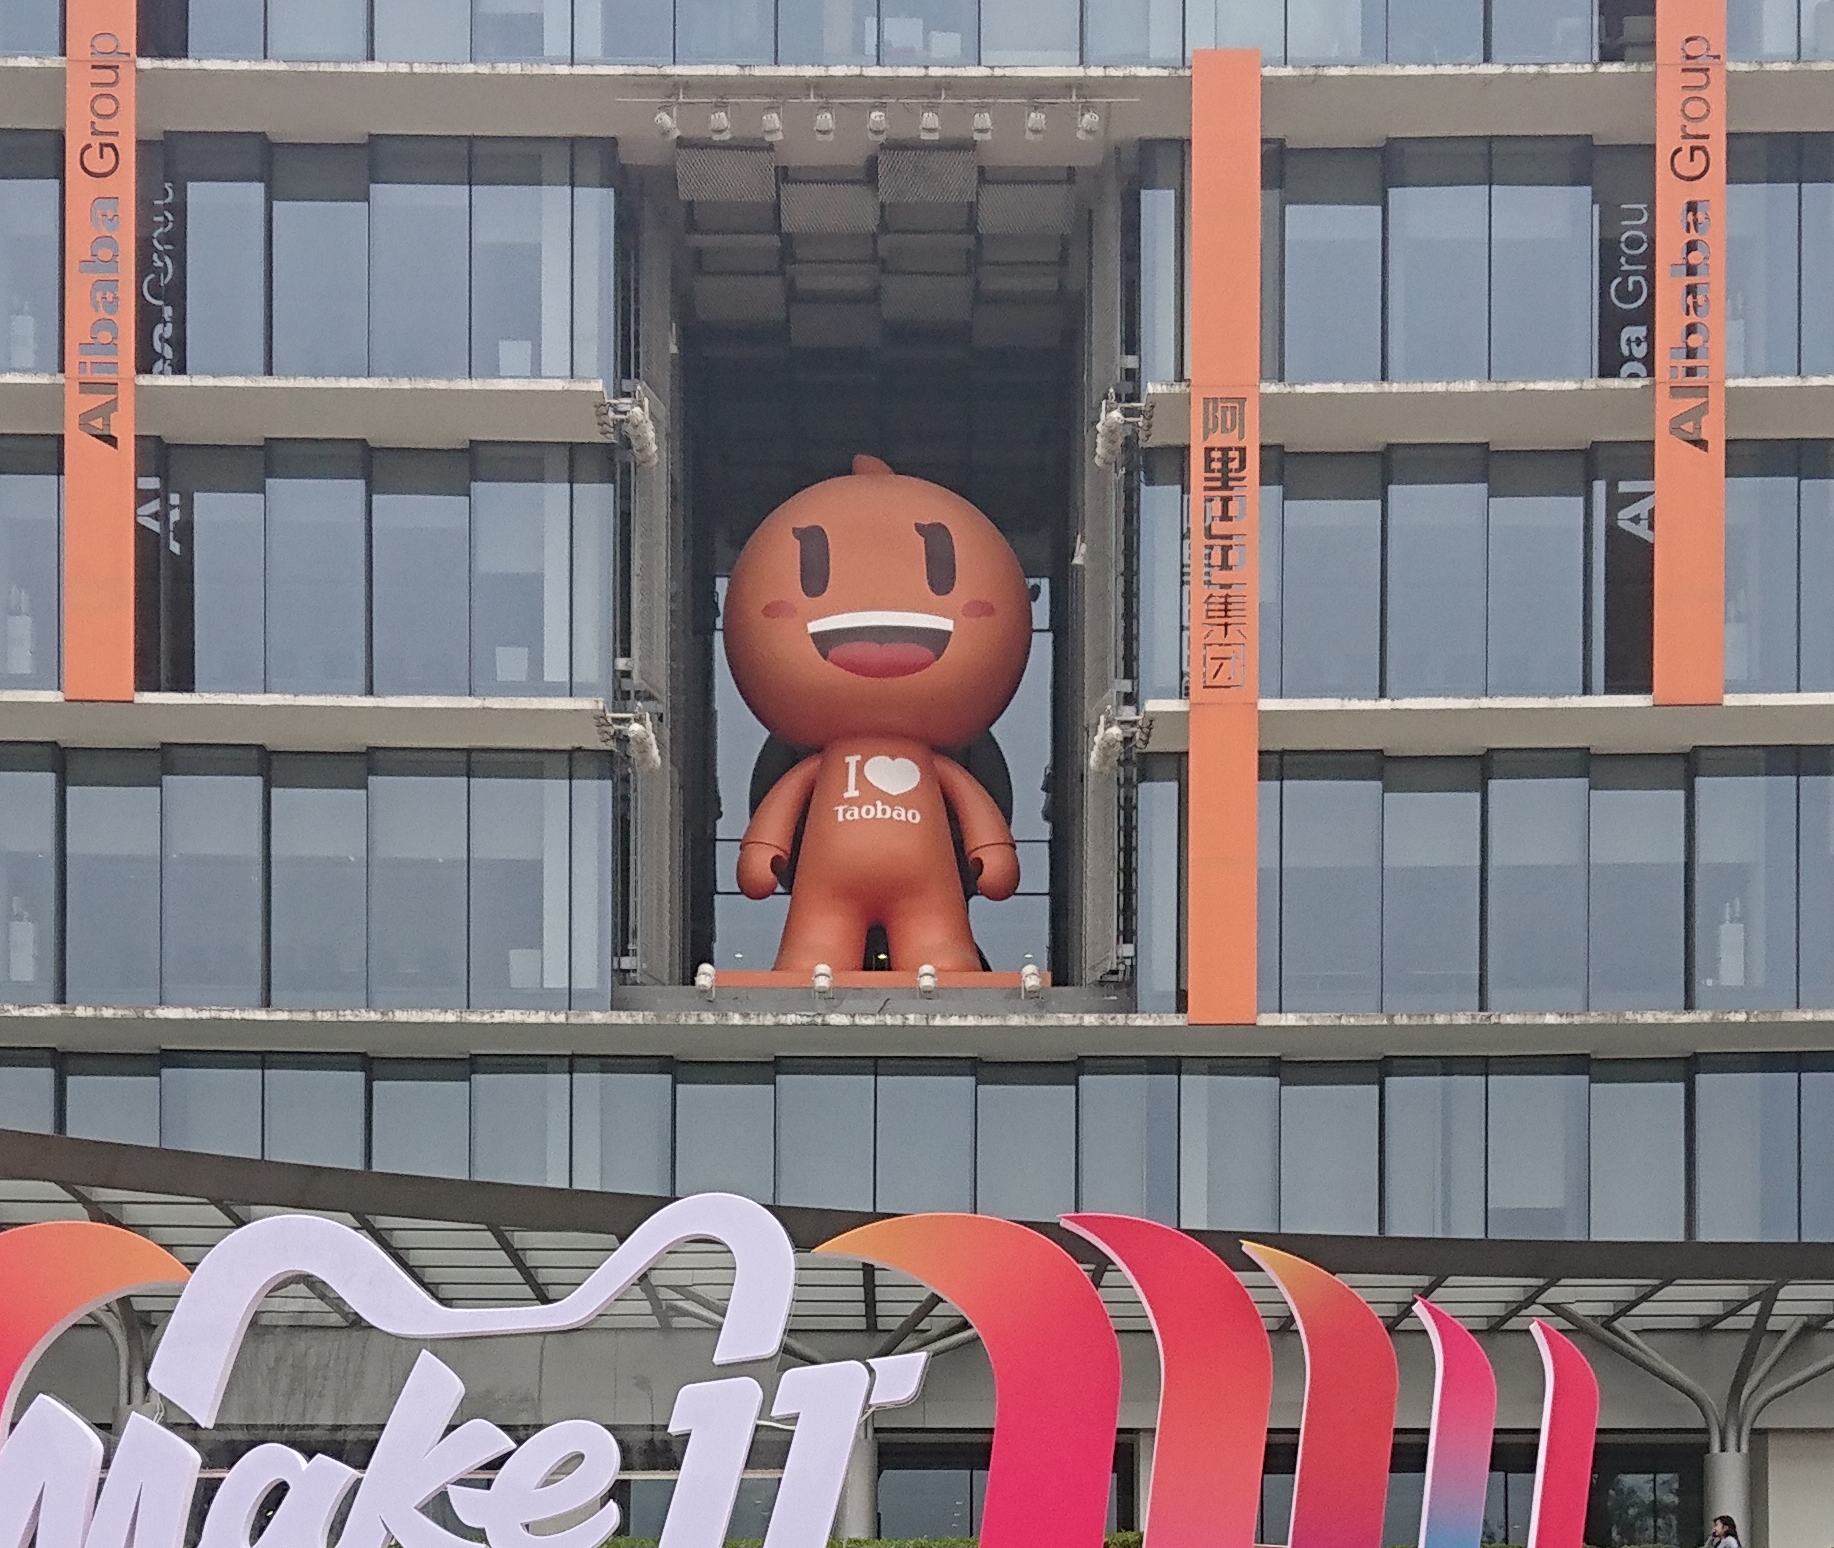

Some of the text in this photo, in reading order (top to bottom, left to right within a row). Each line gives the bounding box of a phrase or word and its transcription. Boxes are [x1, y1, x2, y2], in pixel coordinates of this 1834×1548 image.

[78, 30, 131, 451] Alibaba Group
[1669, 34, 1721, 453] Alibaba Group
[1201, 396, 1248, 690] 阿里巴巴集团
[833, 800, 921, 824] Taobao
[843, 754, 862, 799] I
